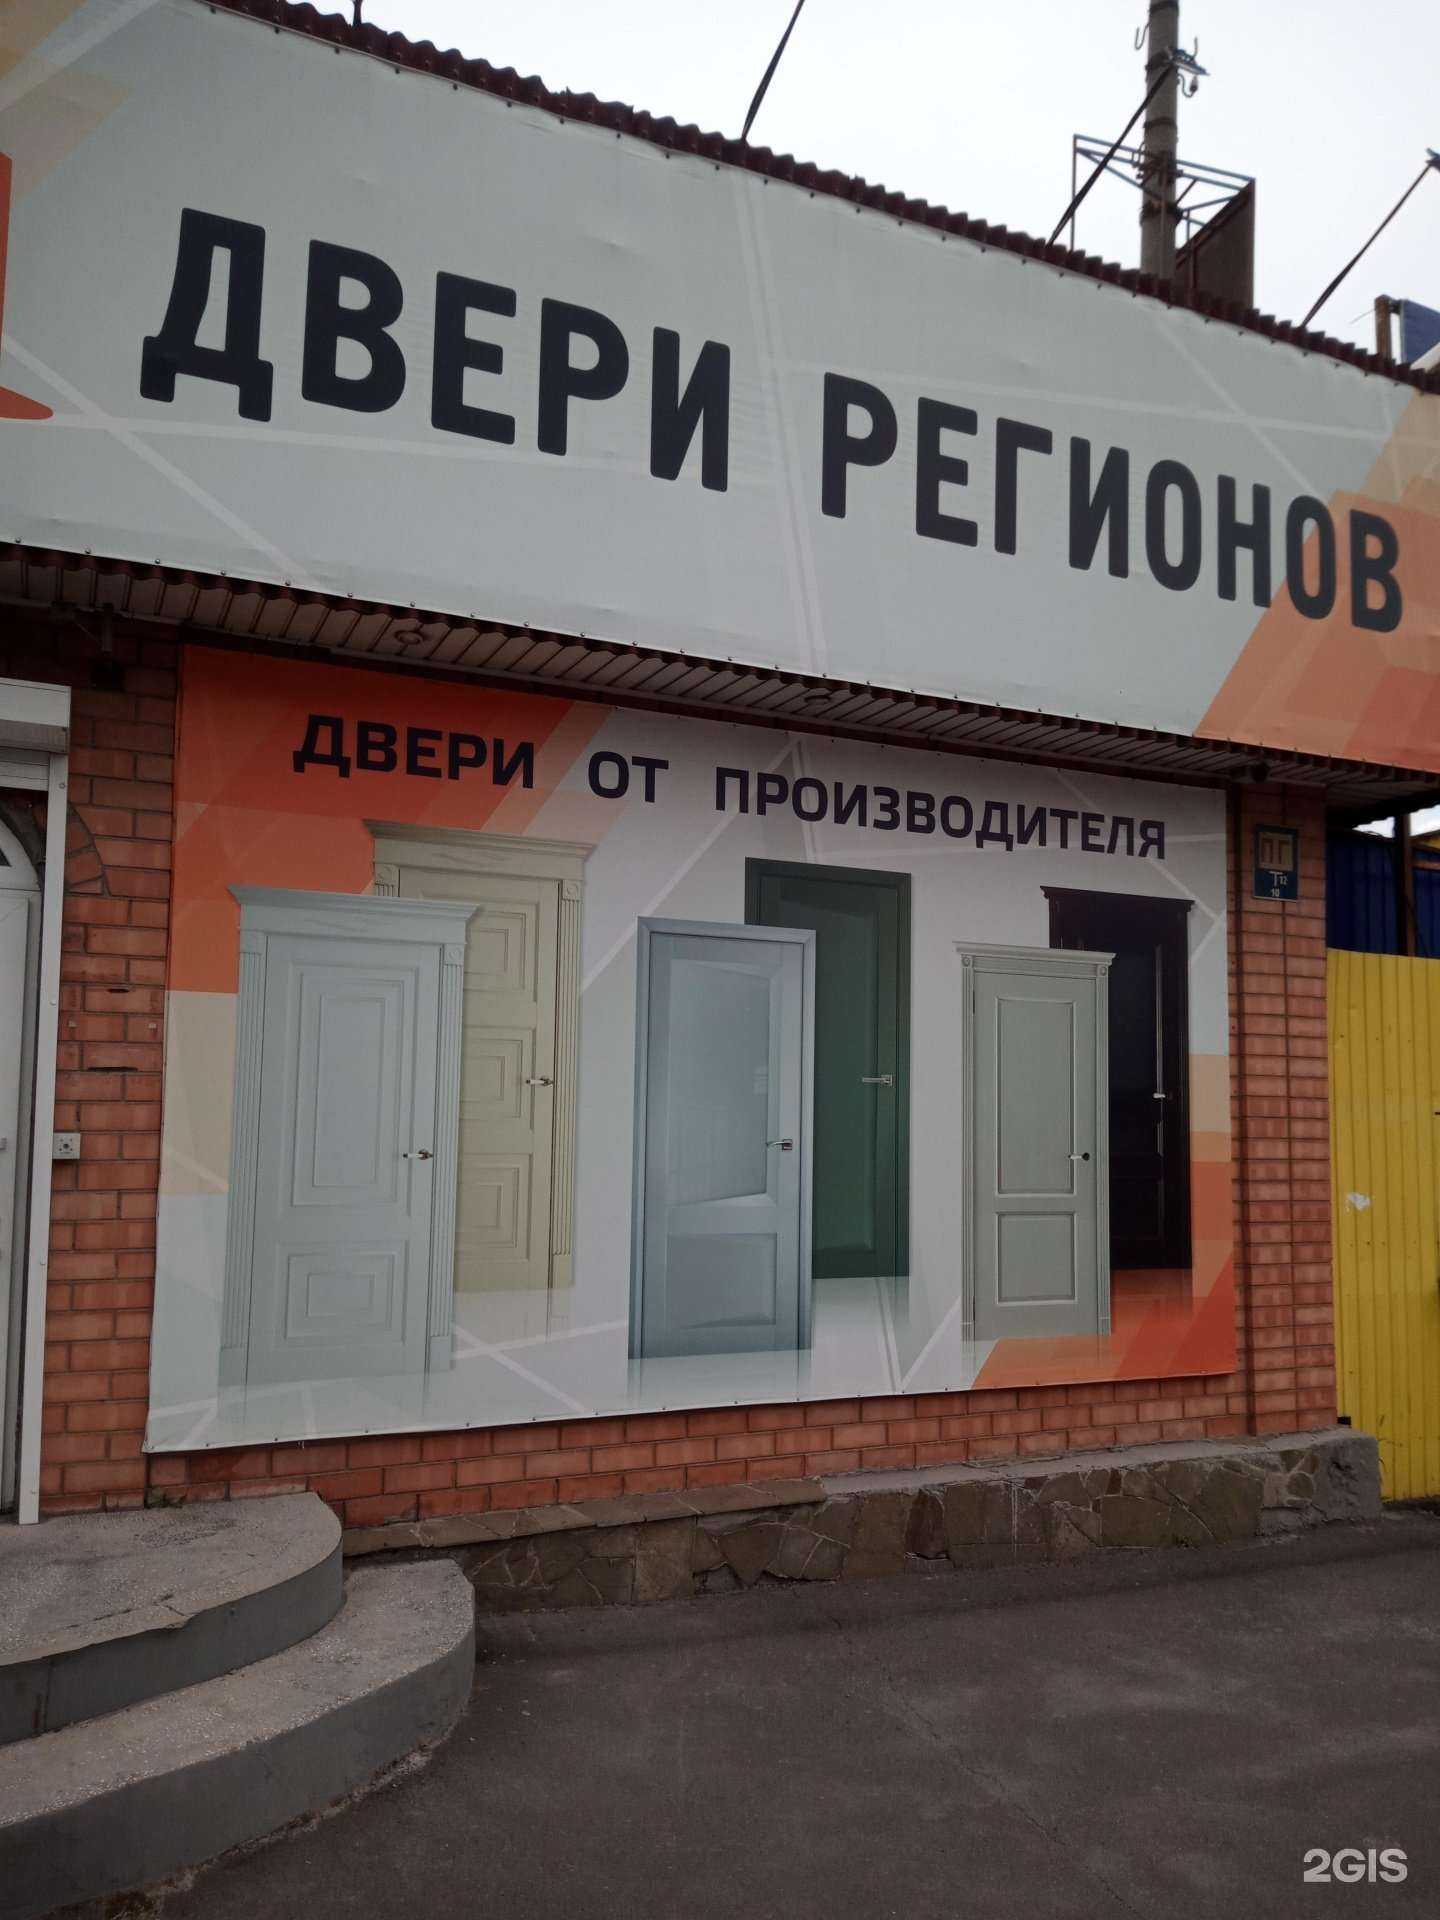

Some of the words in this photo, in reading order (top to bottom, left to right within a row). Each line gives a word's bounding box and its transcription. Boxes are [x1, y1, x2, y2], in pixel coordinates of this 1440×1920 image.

[140, 207, 731, 492] ДВЕРИ
[821, 371, 1403, 633] РЕГИОНОВ
[292, 713, 535, 789] ДВЕРИ
[587, 750, 670, 804] ОТ
[715, 766, 1166, 860] ПРОИЗВОДИТЕЛЯ
